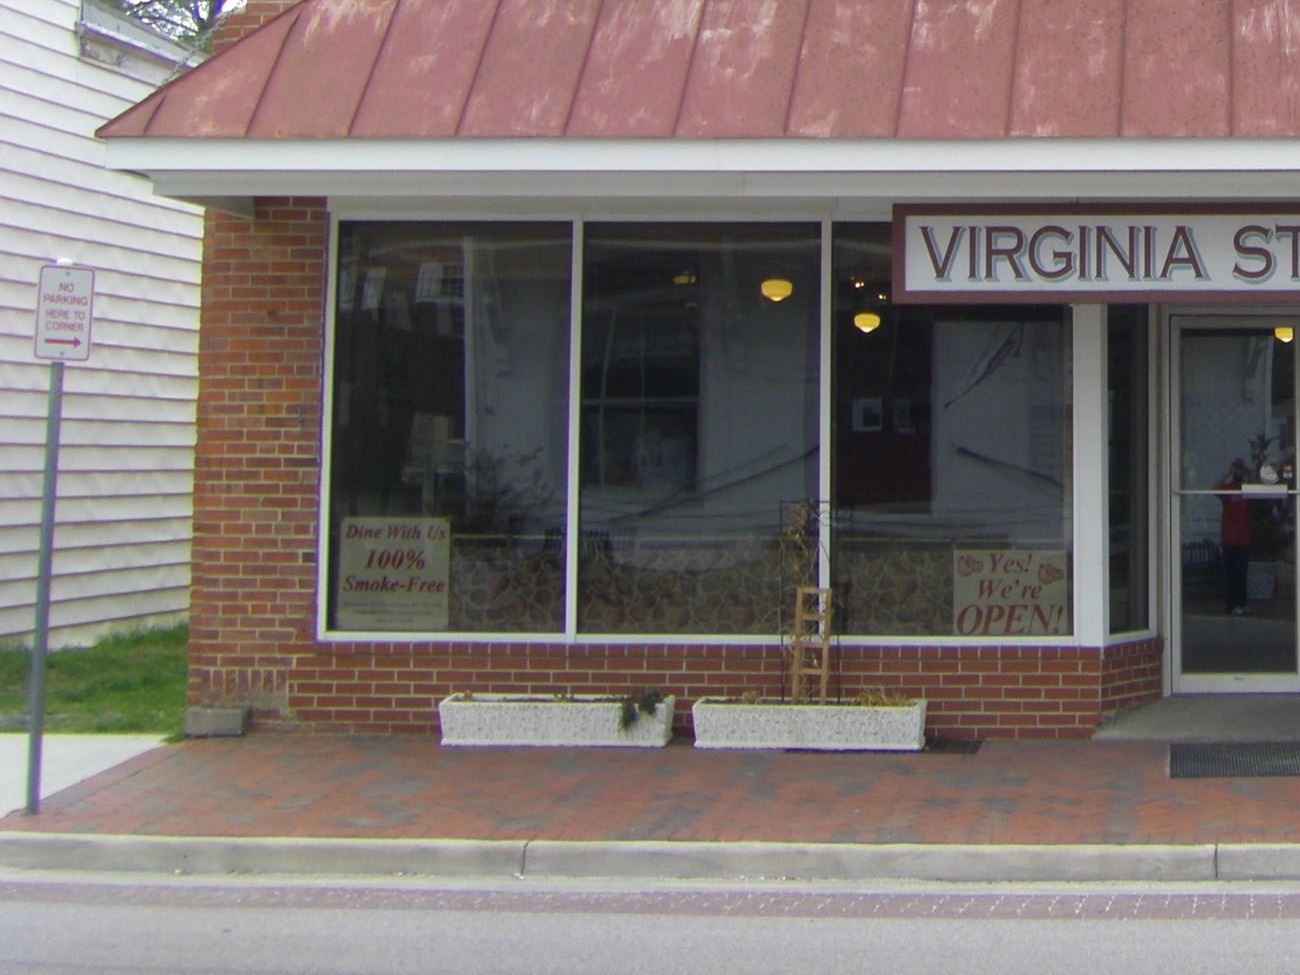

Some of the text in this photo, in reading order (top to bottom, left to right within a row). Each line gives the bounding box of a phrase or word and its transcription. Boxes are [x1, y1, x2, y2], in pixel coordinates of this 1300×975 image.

[919, 225, 1211, 282] VIRGINIA
[59, 282, 74, 293] NO
[43, 294, 88, 306] PARKING
[45, 309, 86, 321] HERE TO
[45, 321, 84, 332] CORNER
[345, 524, 447, 540] Dine With Us
[364, 548, 426, 570] 100%
[989, 553, 1033, 573] Yes!
[342, 576, 446, 593] Smoke-Free
[977, 579, 1042, 599] We're
[956, 604, 1064, 635] OPEN!
